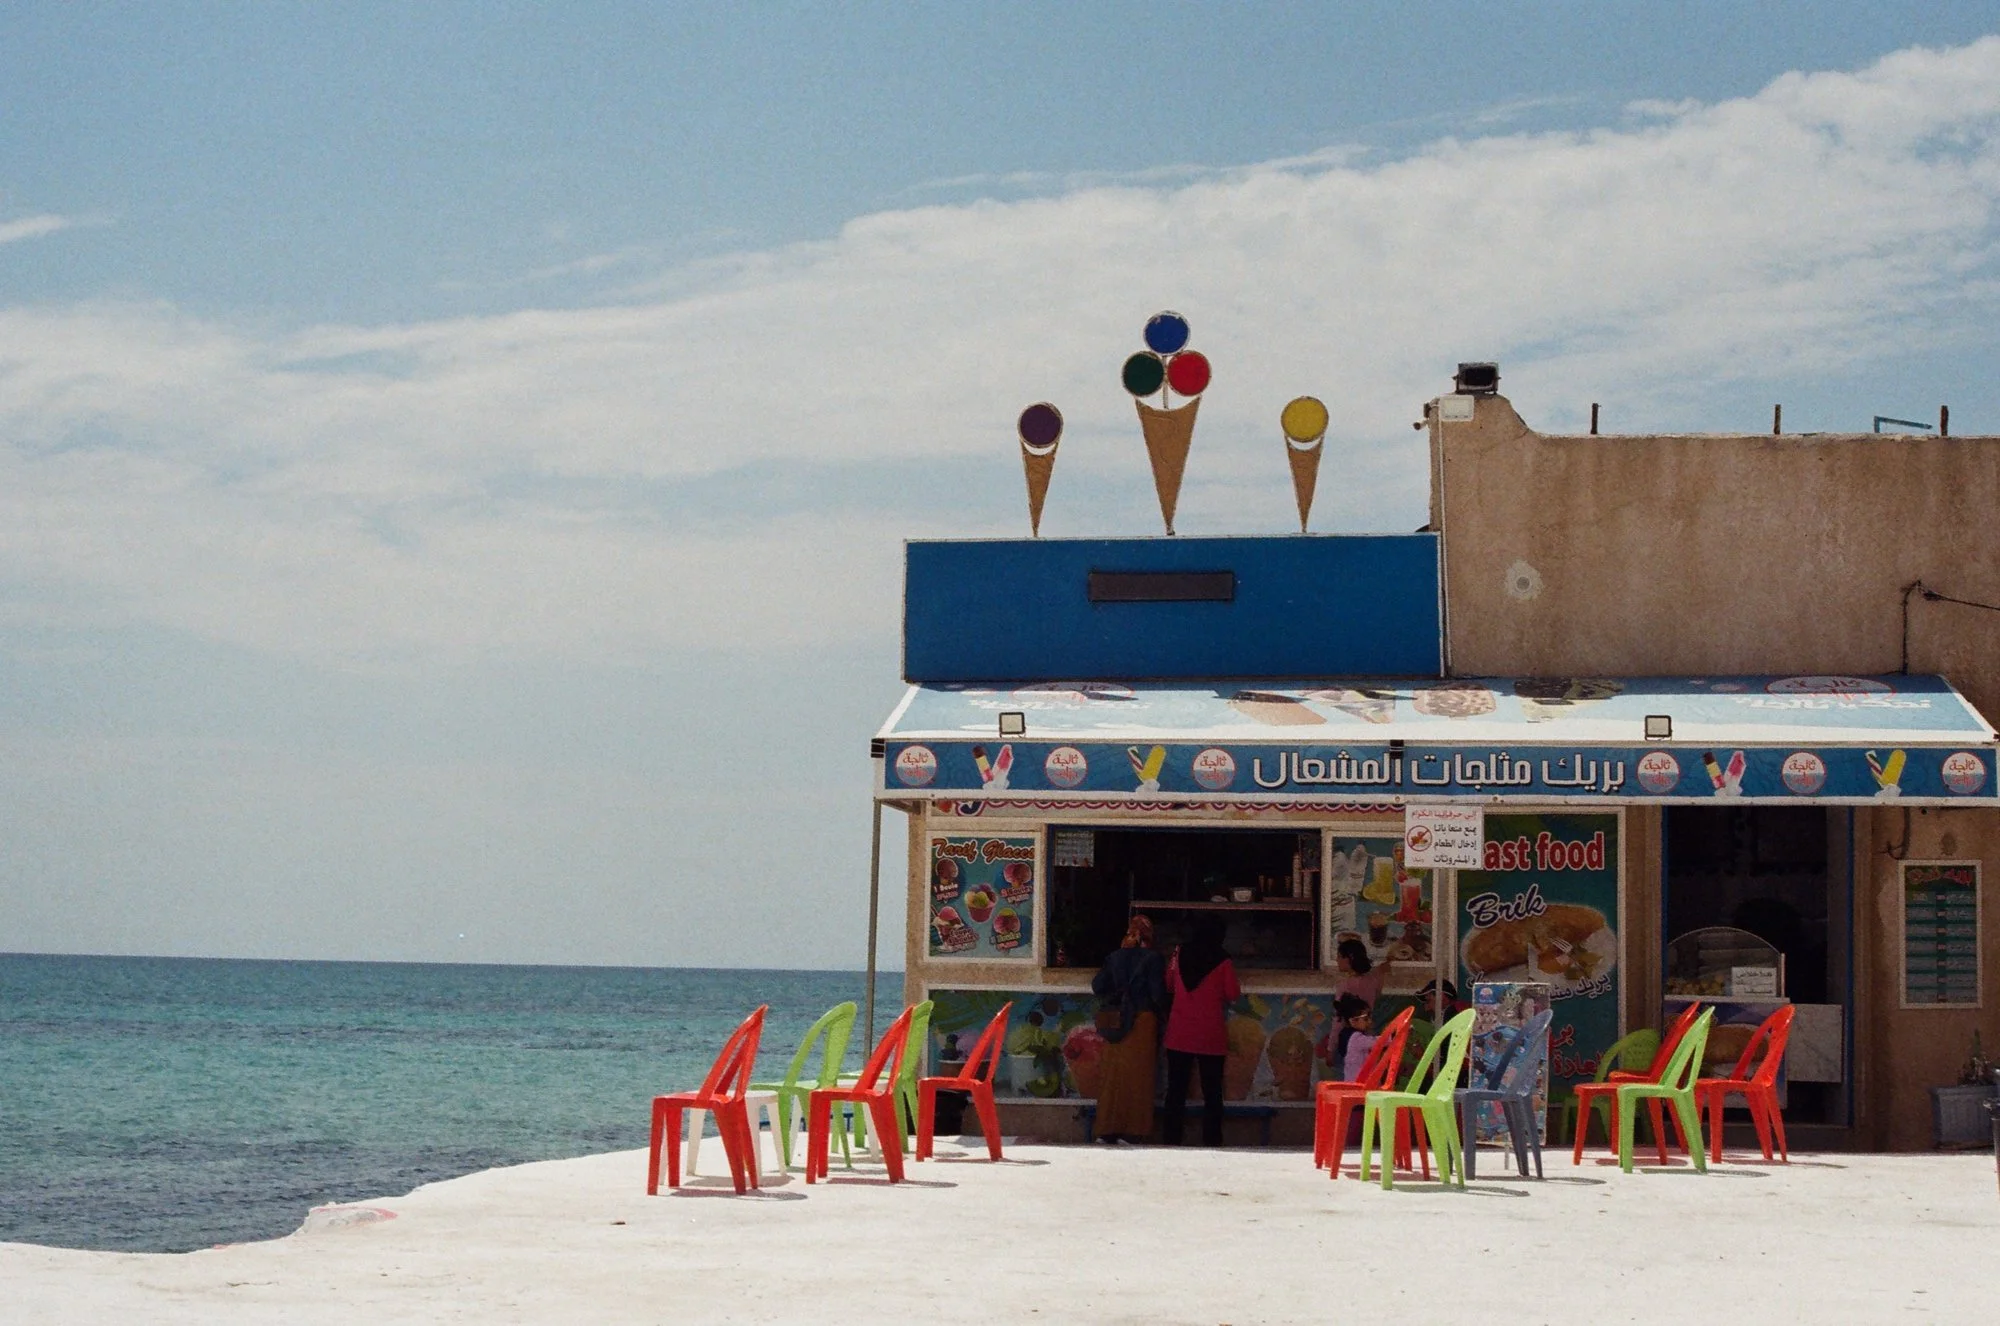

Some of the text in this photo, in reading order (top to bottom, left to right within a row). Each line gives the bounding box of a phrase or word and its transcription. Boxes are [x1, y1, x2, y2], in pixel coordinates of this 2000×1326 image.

[1252, 750, 1625, 793] بريك مثلجات المشعال
[1463, 824, 1477, 837] يمنع
[931, 838, 1035, 864] Tarif Glaces
[1433, 839, 1477, 851] إدخال الطعام
[1484, 831, 1605, 871] ast food
[1466, 883, 1548, 928] Brik
[1573, 973, 1612, 999] بريك
